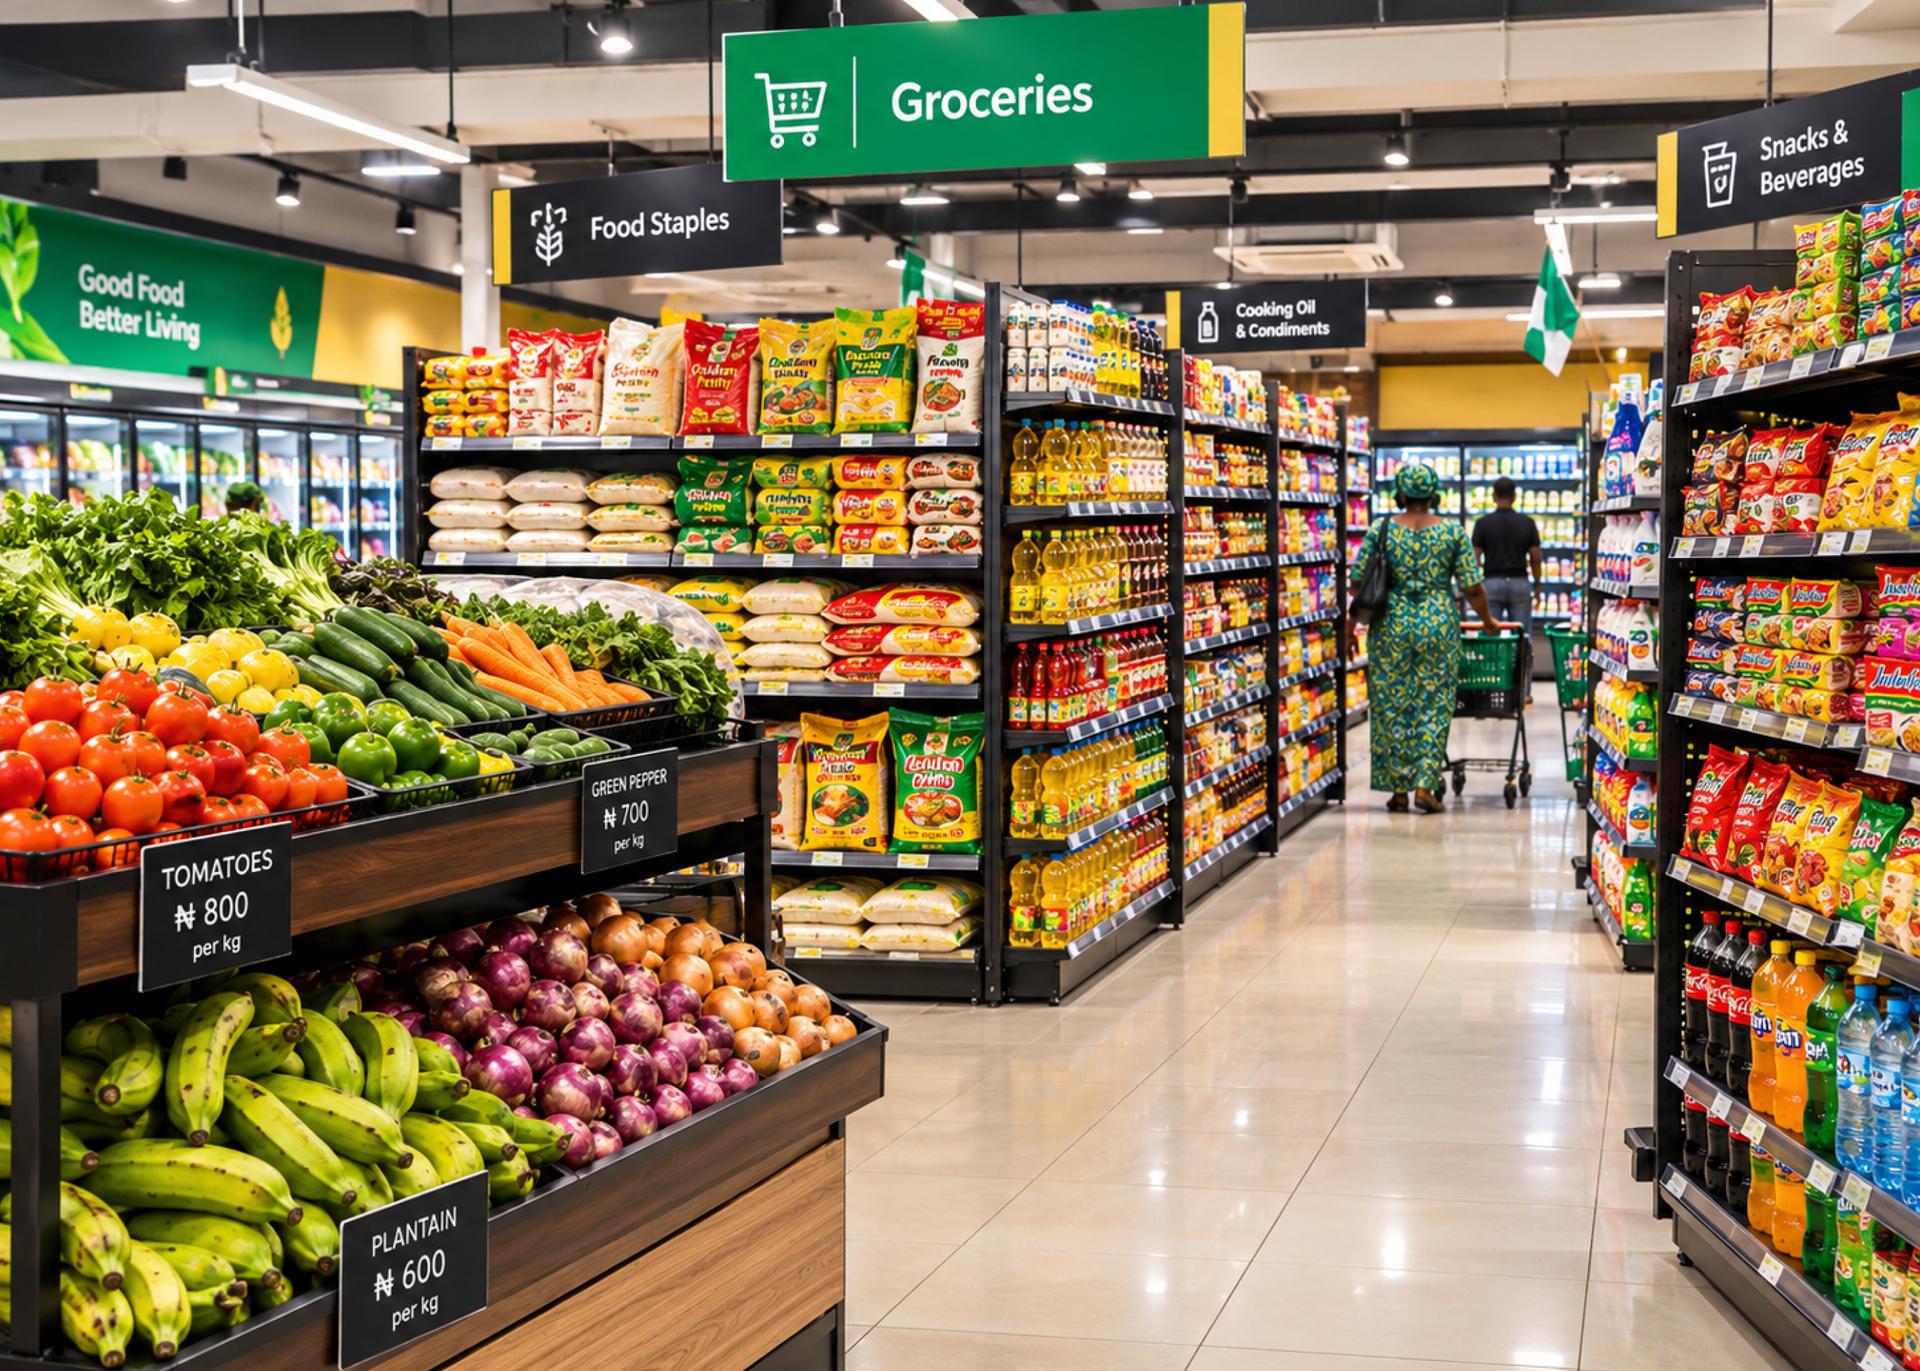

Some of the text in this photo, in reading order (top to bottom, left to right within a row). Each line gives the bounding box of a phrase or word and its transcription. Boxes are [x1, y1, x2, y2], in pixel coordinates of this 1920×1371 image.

[891, 72, 1093, 122] Groceries
[1760, 119, 1849, 161] Snacks &
[1760, 156, 1865, 196] Beverages
[591, 207, 730, 241] Food Staples
[78, 263, 185, 308] Good Food
[79, 299, 201, 351] Better Living
[1235, 299, 1316, 320] Cooking Oil
[1235, 321, 1331, 339] & Condiments
[591, 767, 668, 798] GREEN PEPPER
[621, 799, 649, 826] 700
[614, 833, 645, 855] per kg
[161, 848, 273, 890] TOMATOES
[204, 891, 249, 926] 800
[193, 934, 241, 964] per kg
[371, 1205, 458, 1259] PLANTAIN
[402, 1248, 446, 1290] 600
[392, 1295, 439, 1332] per kg
